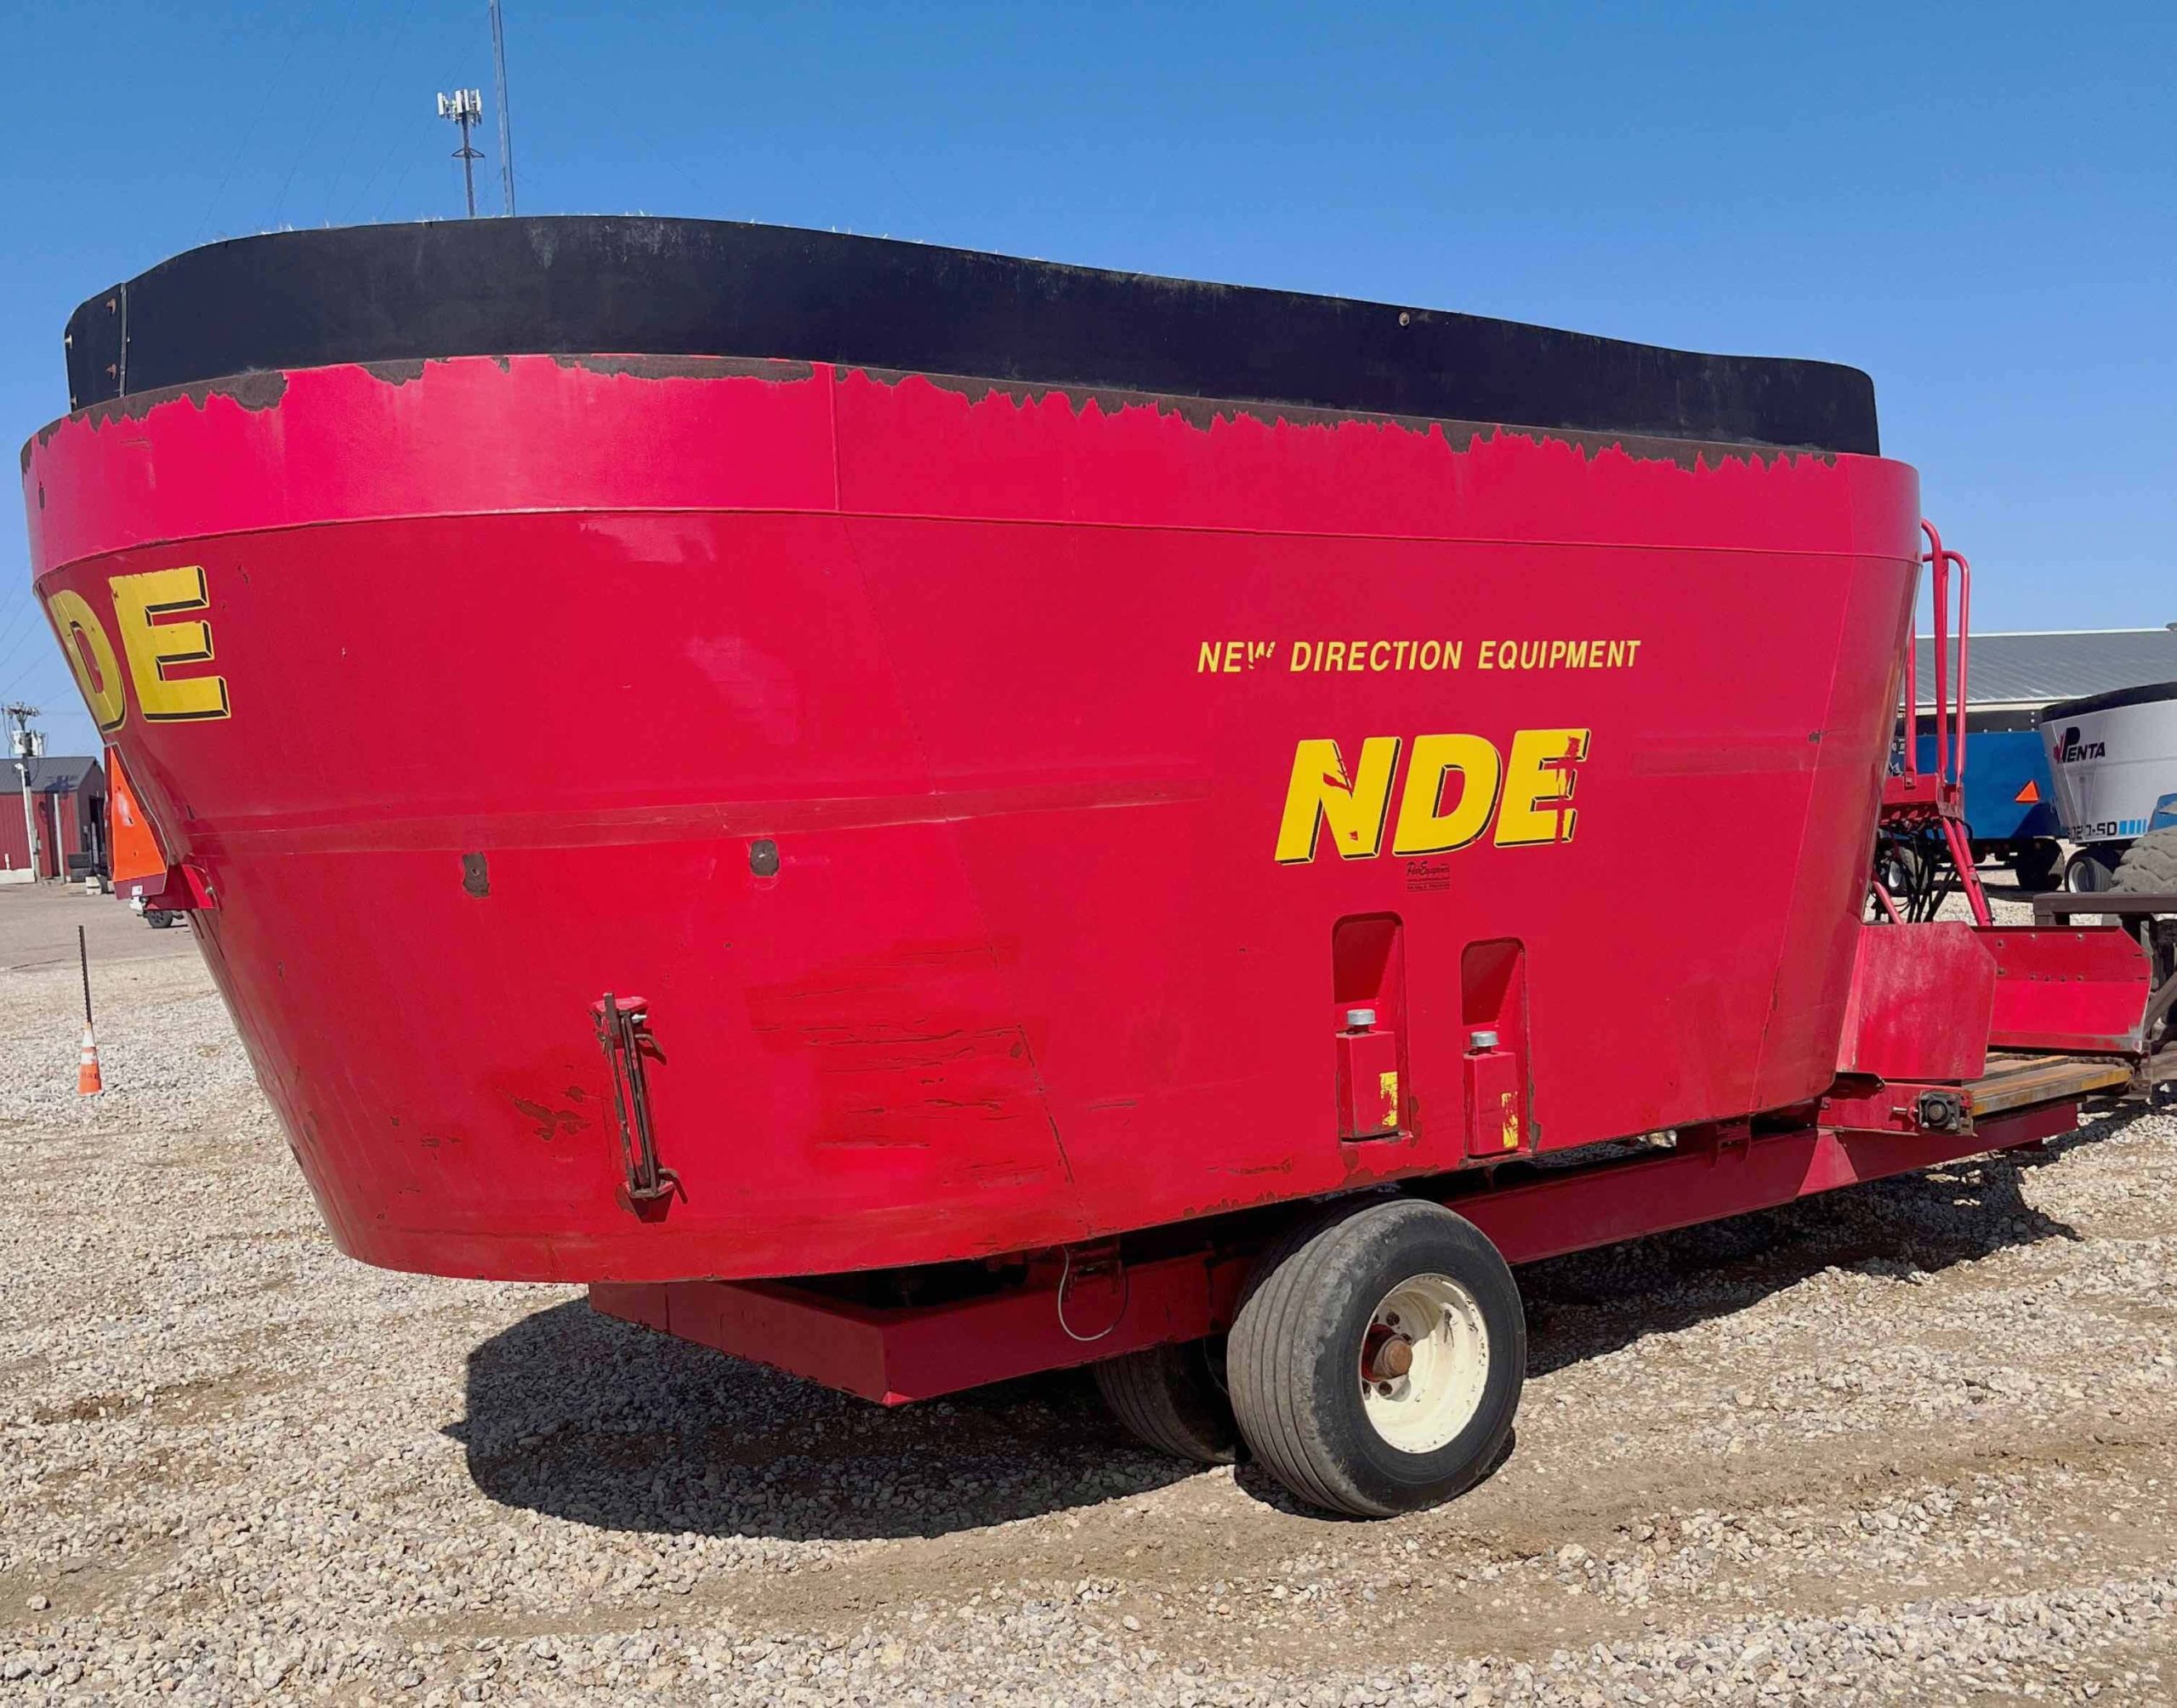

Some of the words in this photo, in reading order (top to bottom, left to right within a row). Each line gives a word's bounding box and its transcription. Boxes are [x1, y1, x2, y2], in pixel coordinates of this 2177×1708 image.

[1289, 640, 1464, 672] DIRECTION
[1477, 639, 1642, 670] EQUIPMENT
[2061, 726, 2106, 763] PENTA
[1274, 729, 1591, 865] NDE
